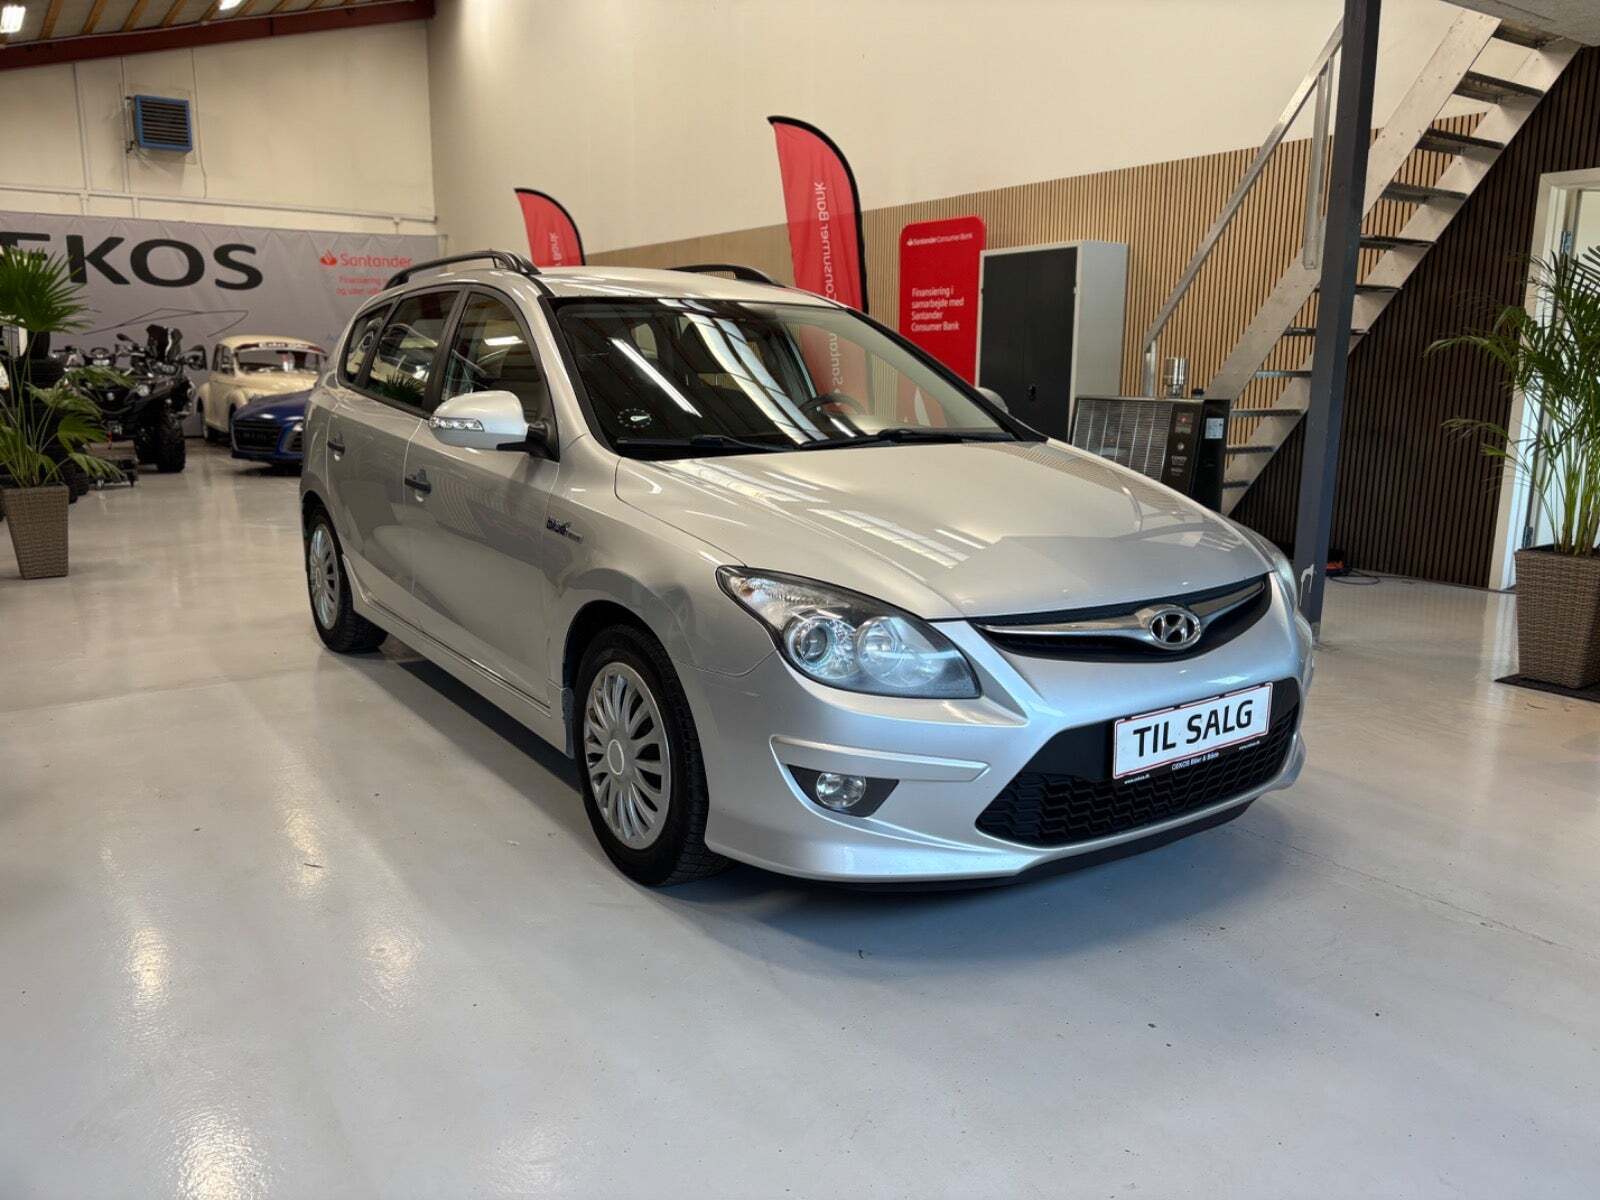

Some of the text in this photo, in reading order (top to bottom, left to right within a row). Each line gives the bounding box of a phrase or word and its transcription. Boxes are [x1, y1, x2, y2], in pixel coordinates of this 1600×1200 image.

[340, 250, 412, 268] Santander
[912, 297, 965, 310] samarbejde med
[912, 311, 943, 321] Santander
[911, 321, 960, 332] Consumer Bank
[1133, 700, 1253, 757] TIL SALG
